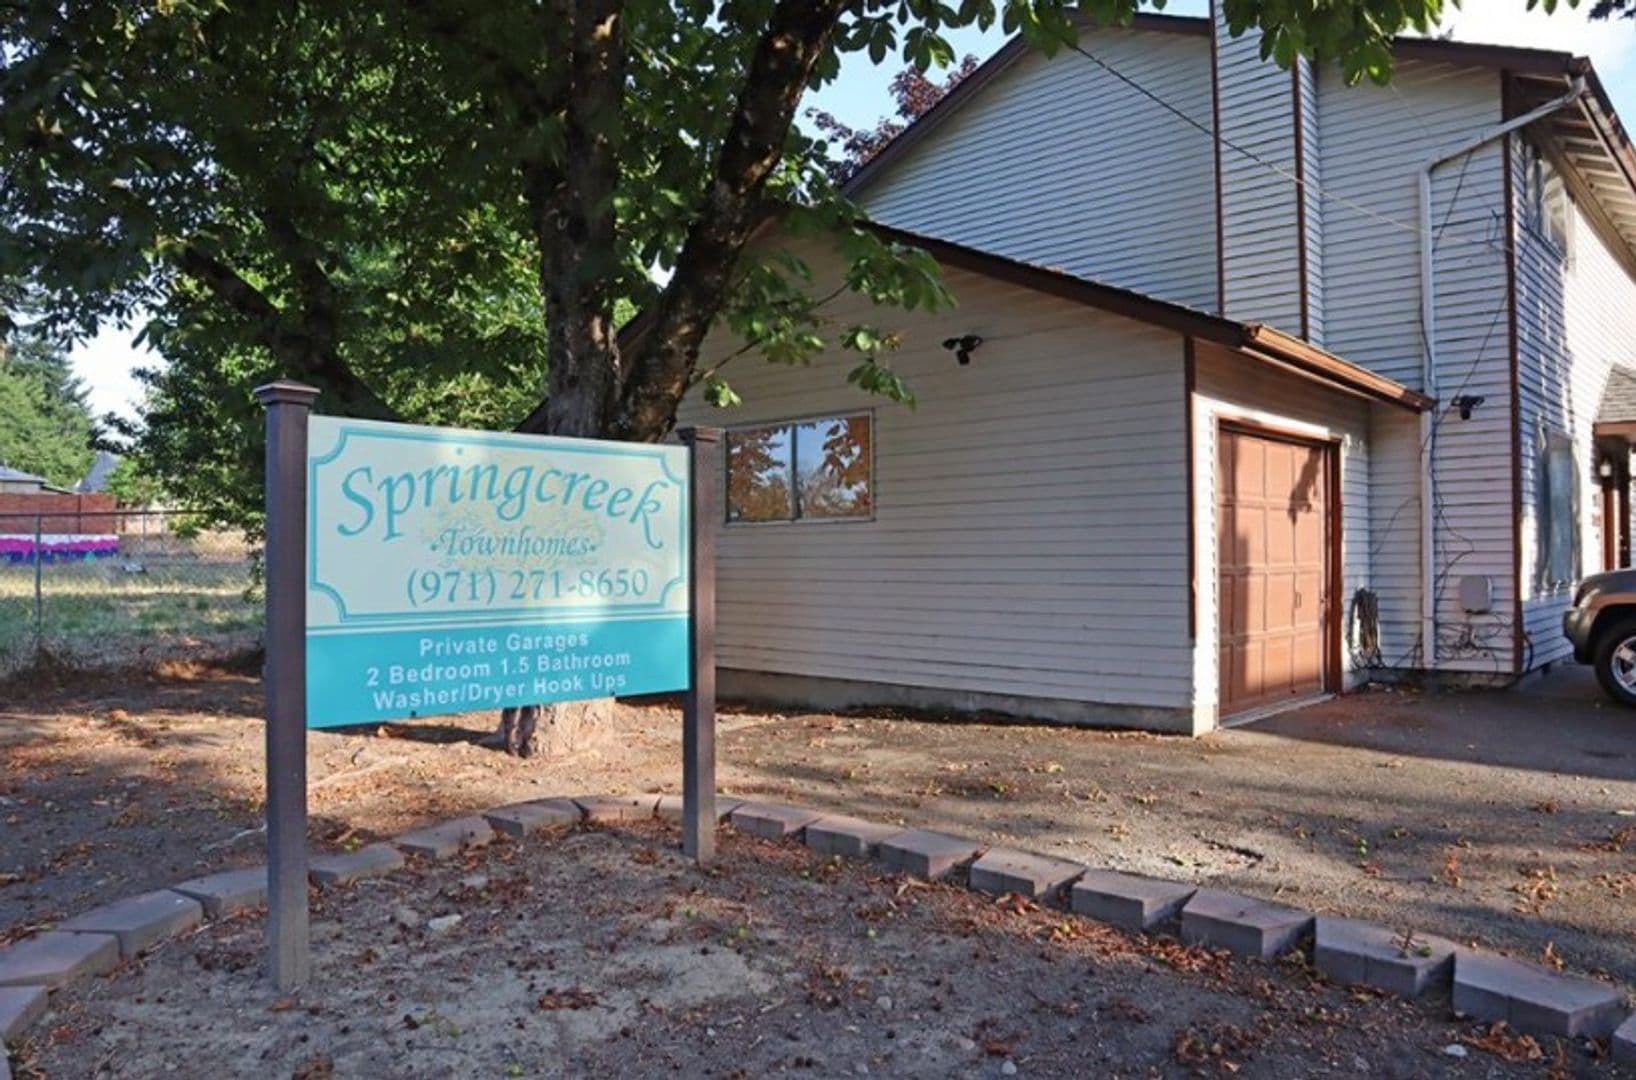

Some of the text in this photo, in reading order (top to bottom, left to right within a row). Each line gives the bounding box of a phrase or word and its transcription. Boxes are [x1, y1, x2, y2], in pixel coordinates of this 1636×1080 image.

[337, 447, 669, 549] Springcreek
[407, 568, 648, 608] (971) 271-8650
[419, 632, 589, 657] Private Garages
[366, 651, 631, 687] 2 Bedroom 1.5 Bathroom
[373, 671, 627, 711] Washer/Dryer Hook Ups
